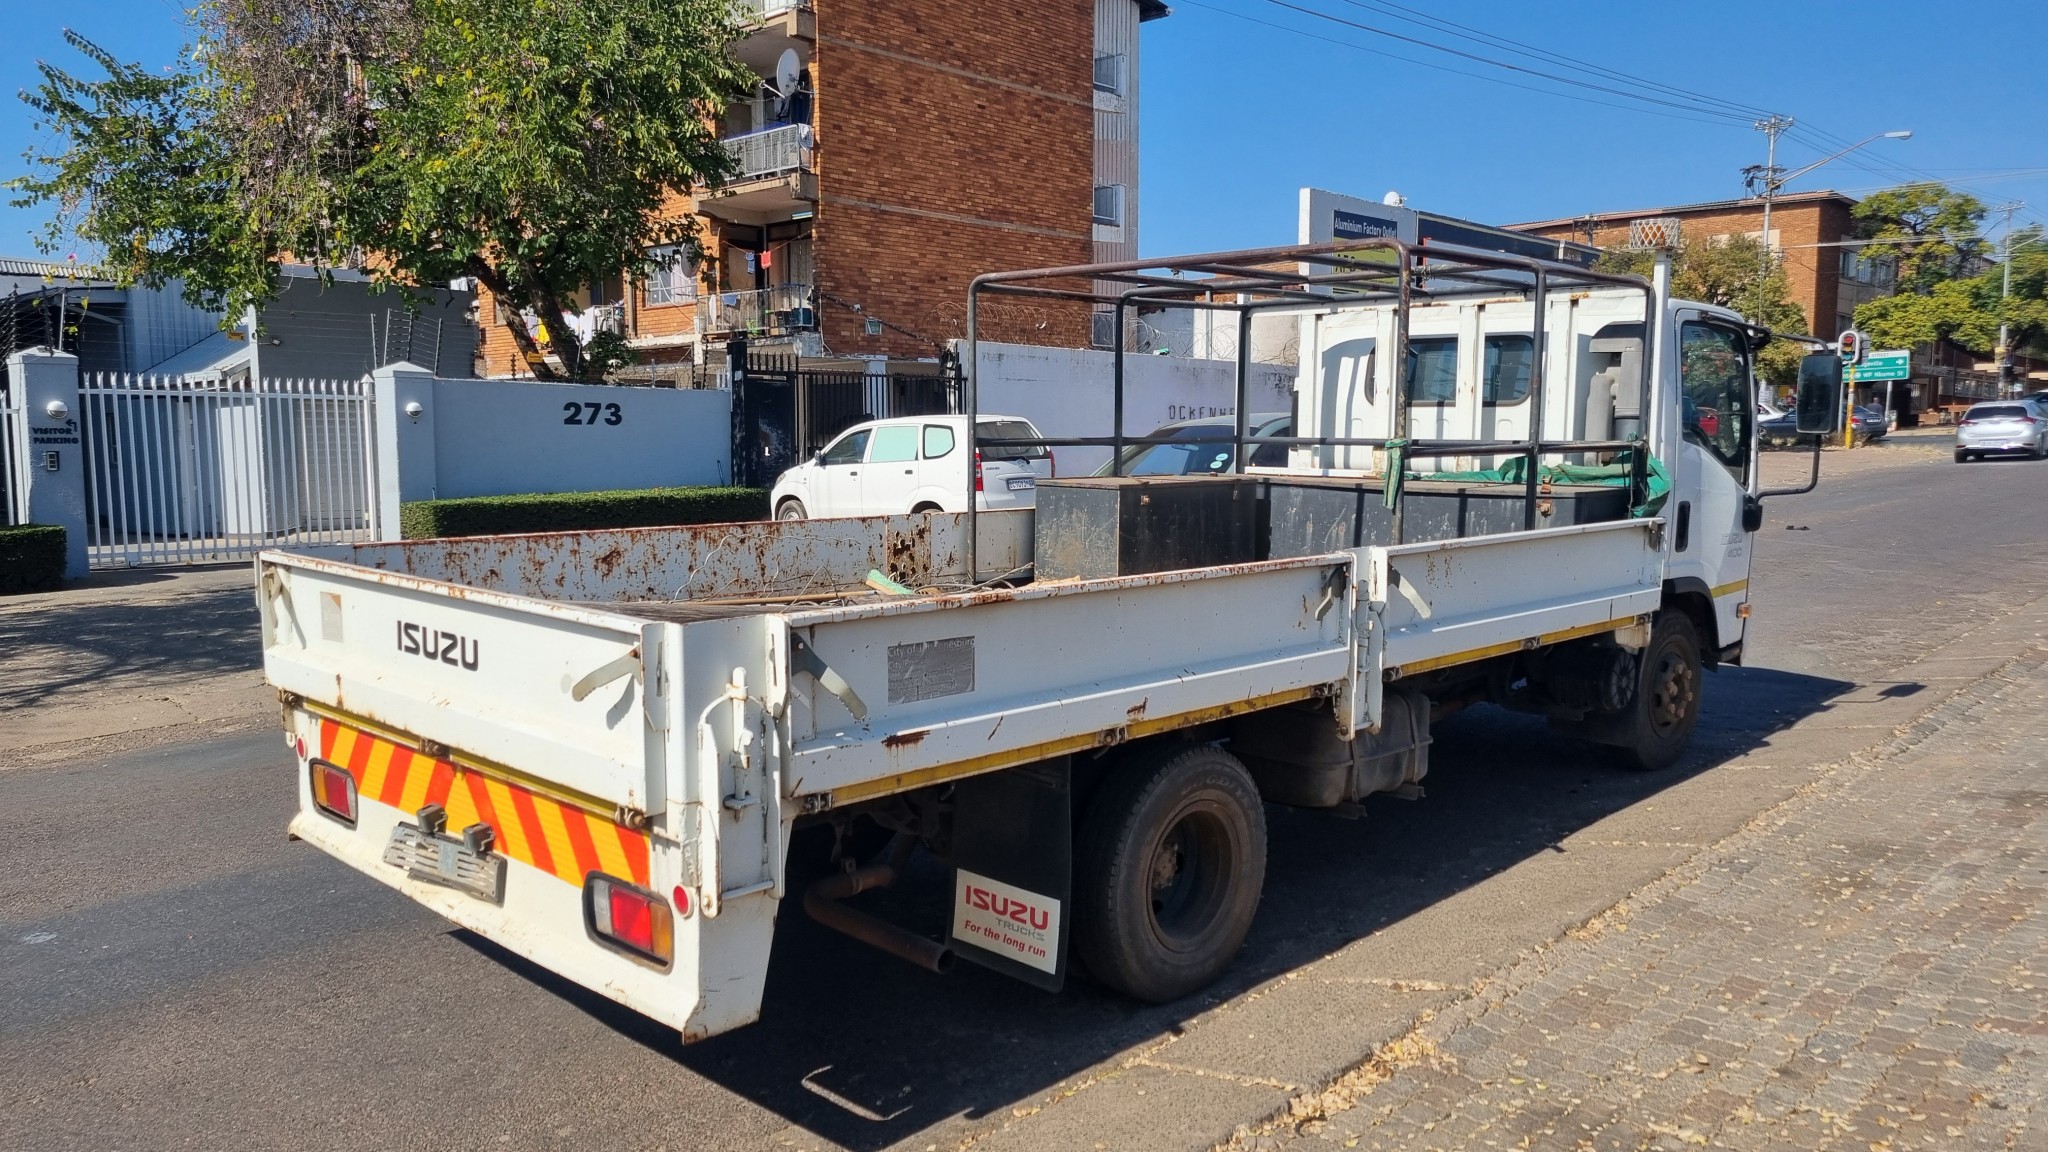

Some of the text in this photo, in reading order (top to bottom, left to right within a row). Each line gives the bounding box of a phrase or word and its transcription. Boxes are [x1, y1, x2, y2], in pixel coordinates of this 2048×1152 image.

[1334, 217, 1397, 238] Aluminium Factory Outlet
[563, 402, 623, 426] 273
[32, 427, 73, 435] VISITOR
[33, 437, 79, 445] PARKING
[397, 620, 479, 672] ISUZU
[888, 647, 904, 658] City
[906, 643, 916, 655] of
[965, 885, 1049, 930] ISUZU
[964, 920, 1046, 958] For the long run
[995, 917, 1046, 942] TRUCKS
